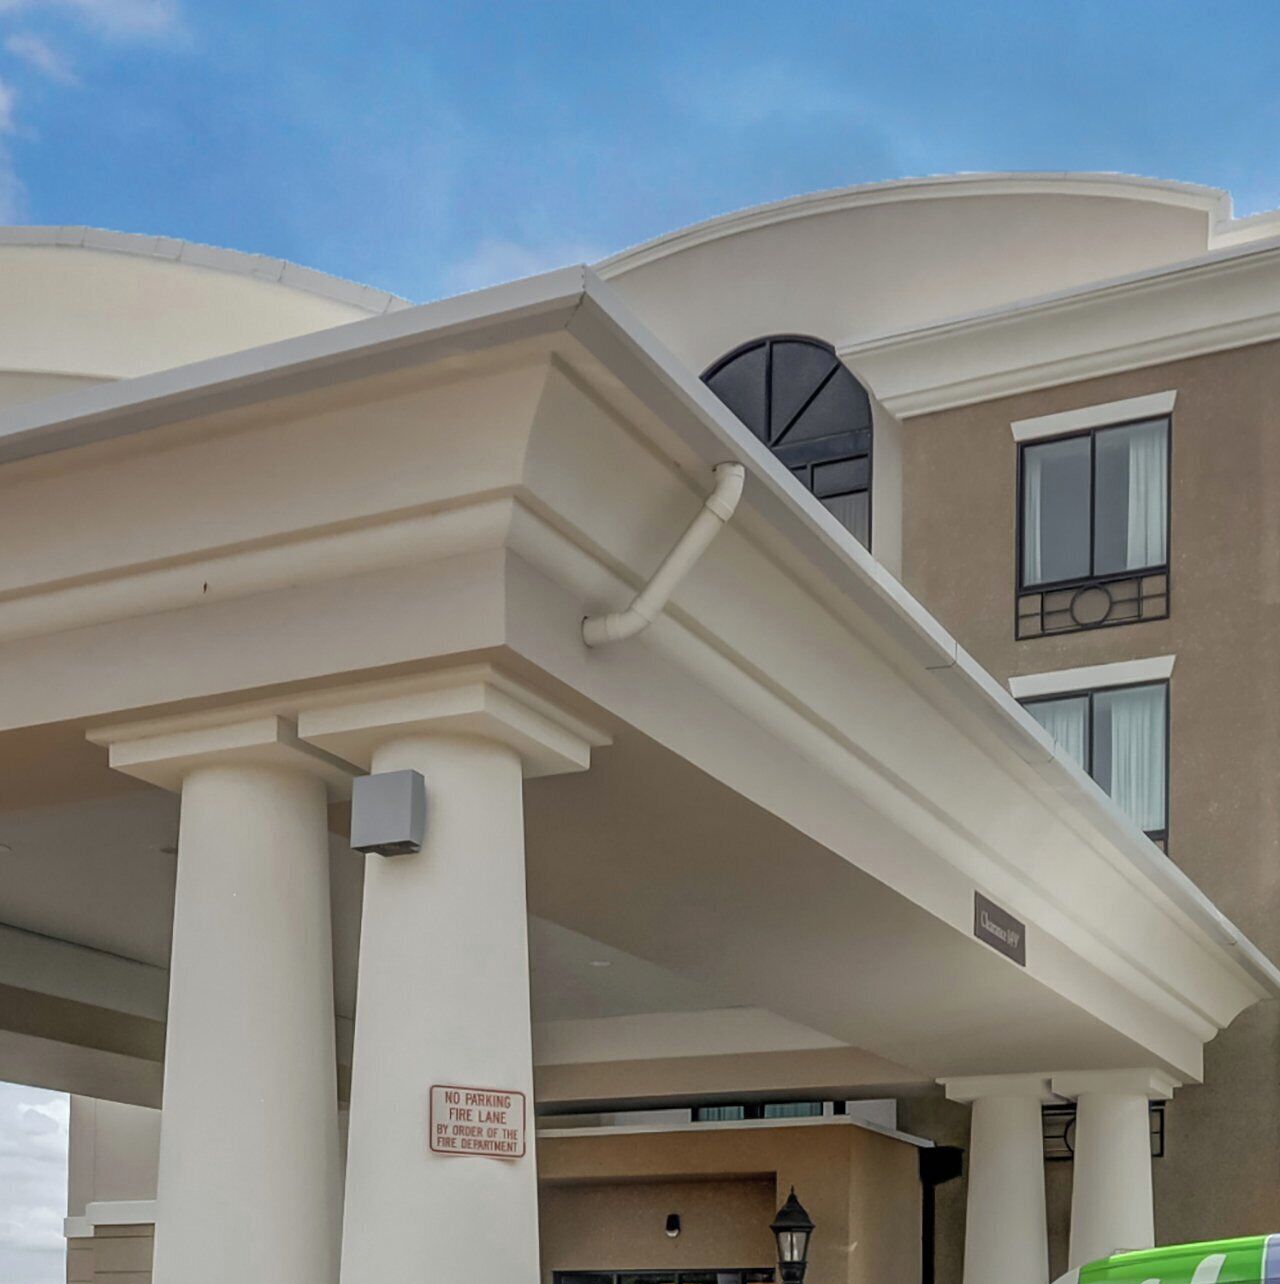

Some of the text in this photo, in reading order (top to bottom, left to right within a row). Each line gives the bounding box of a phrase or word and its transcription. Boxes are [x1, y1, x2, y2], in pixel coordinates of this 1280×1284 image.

[445, 1091, 511, 1109] NO PARKING
[449, 1107, 507, 1124] FIRE LANE
[437, 1123, 518, 1140] BY ORDER OF THE
[437, 1136, 518, 1153] FIRE DEPARTMENT
